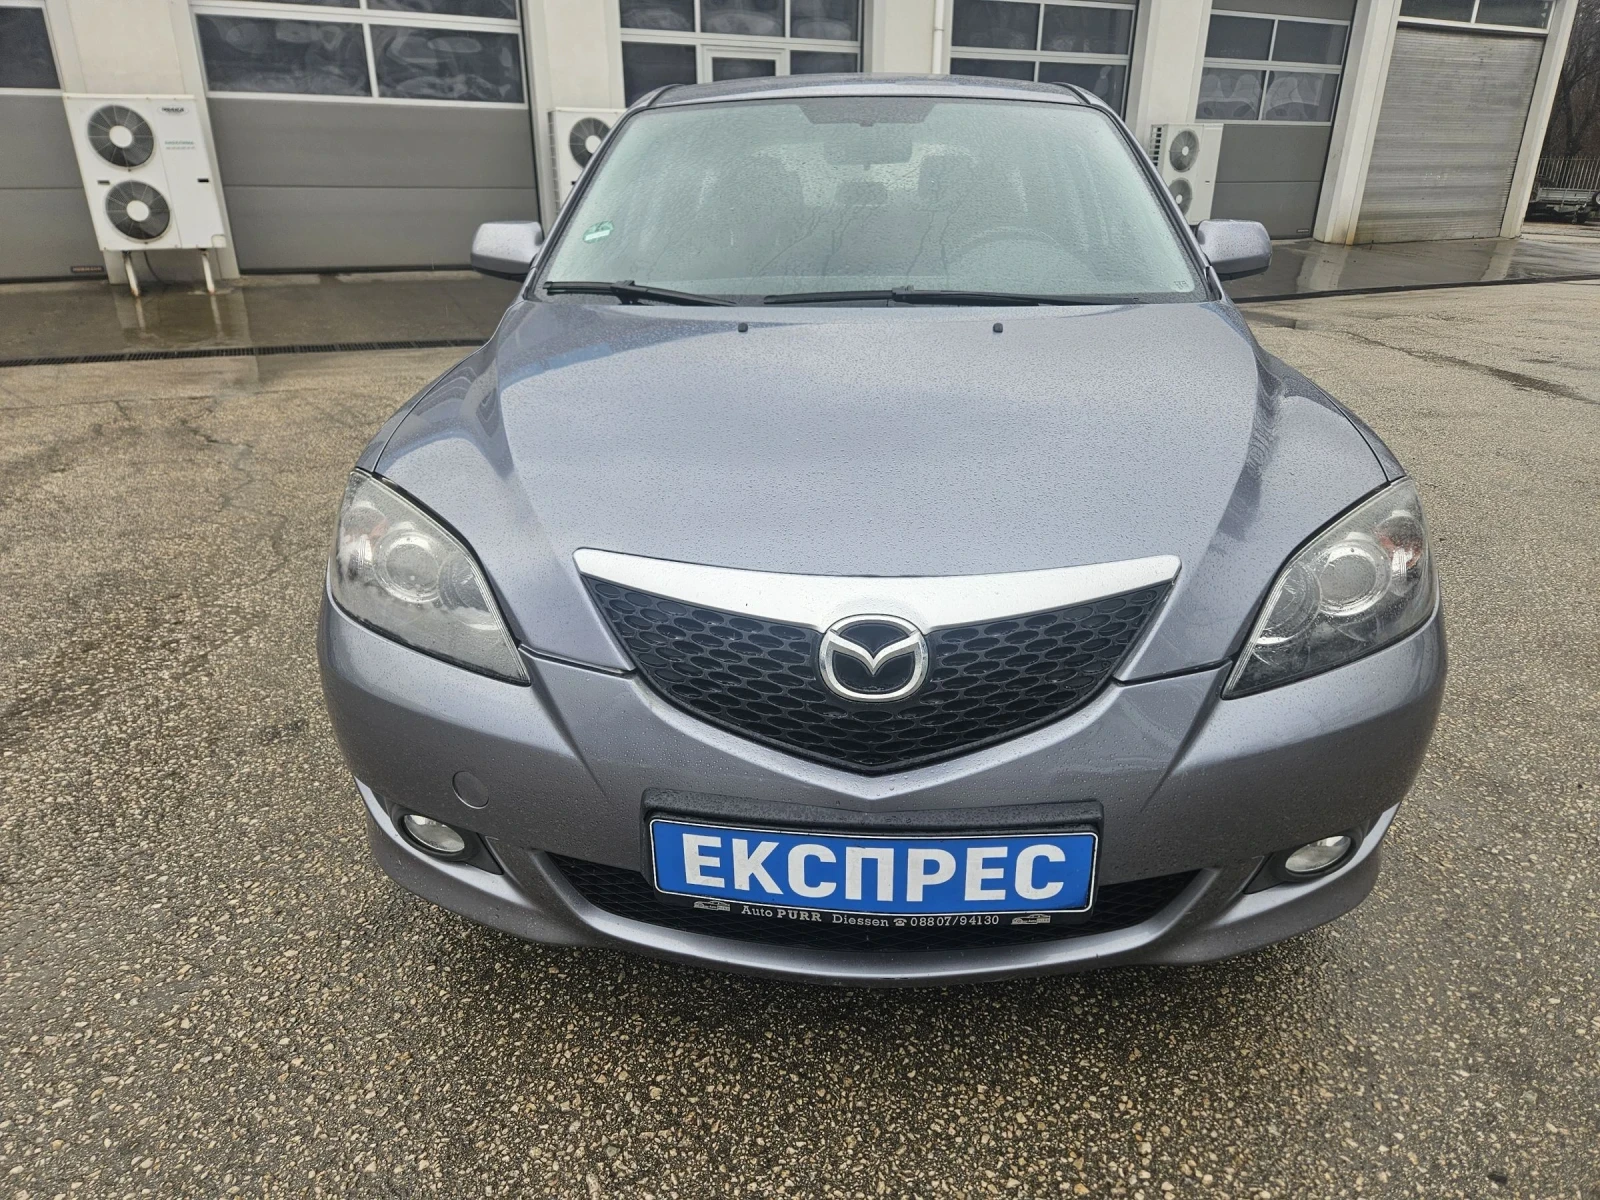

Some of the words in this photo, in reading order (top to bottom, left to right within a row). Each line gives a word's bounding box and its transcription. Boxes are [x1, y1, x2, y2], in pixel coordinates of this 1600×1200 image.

[682, 833, 1066, 902] ЕКСПРЕС
[741, 905, 773, 917] Auto
[777, 909, 822, 922] PURR
[832, 914, 889, 926] Diessen
